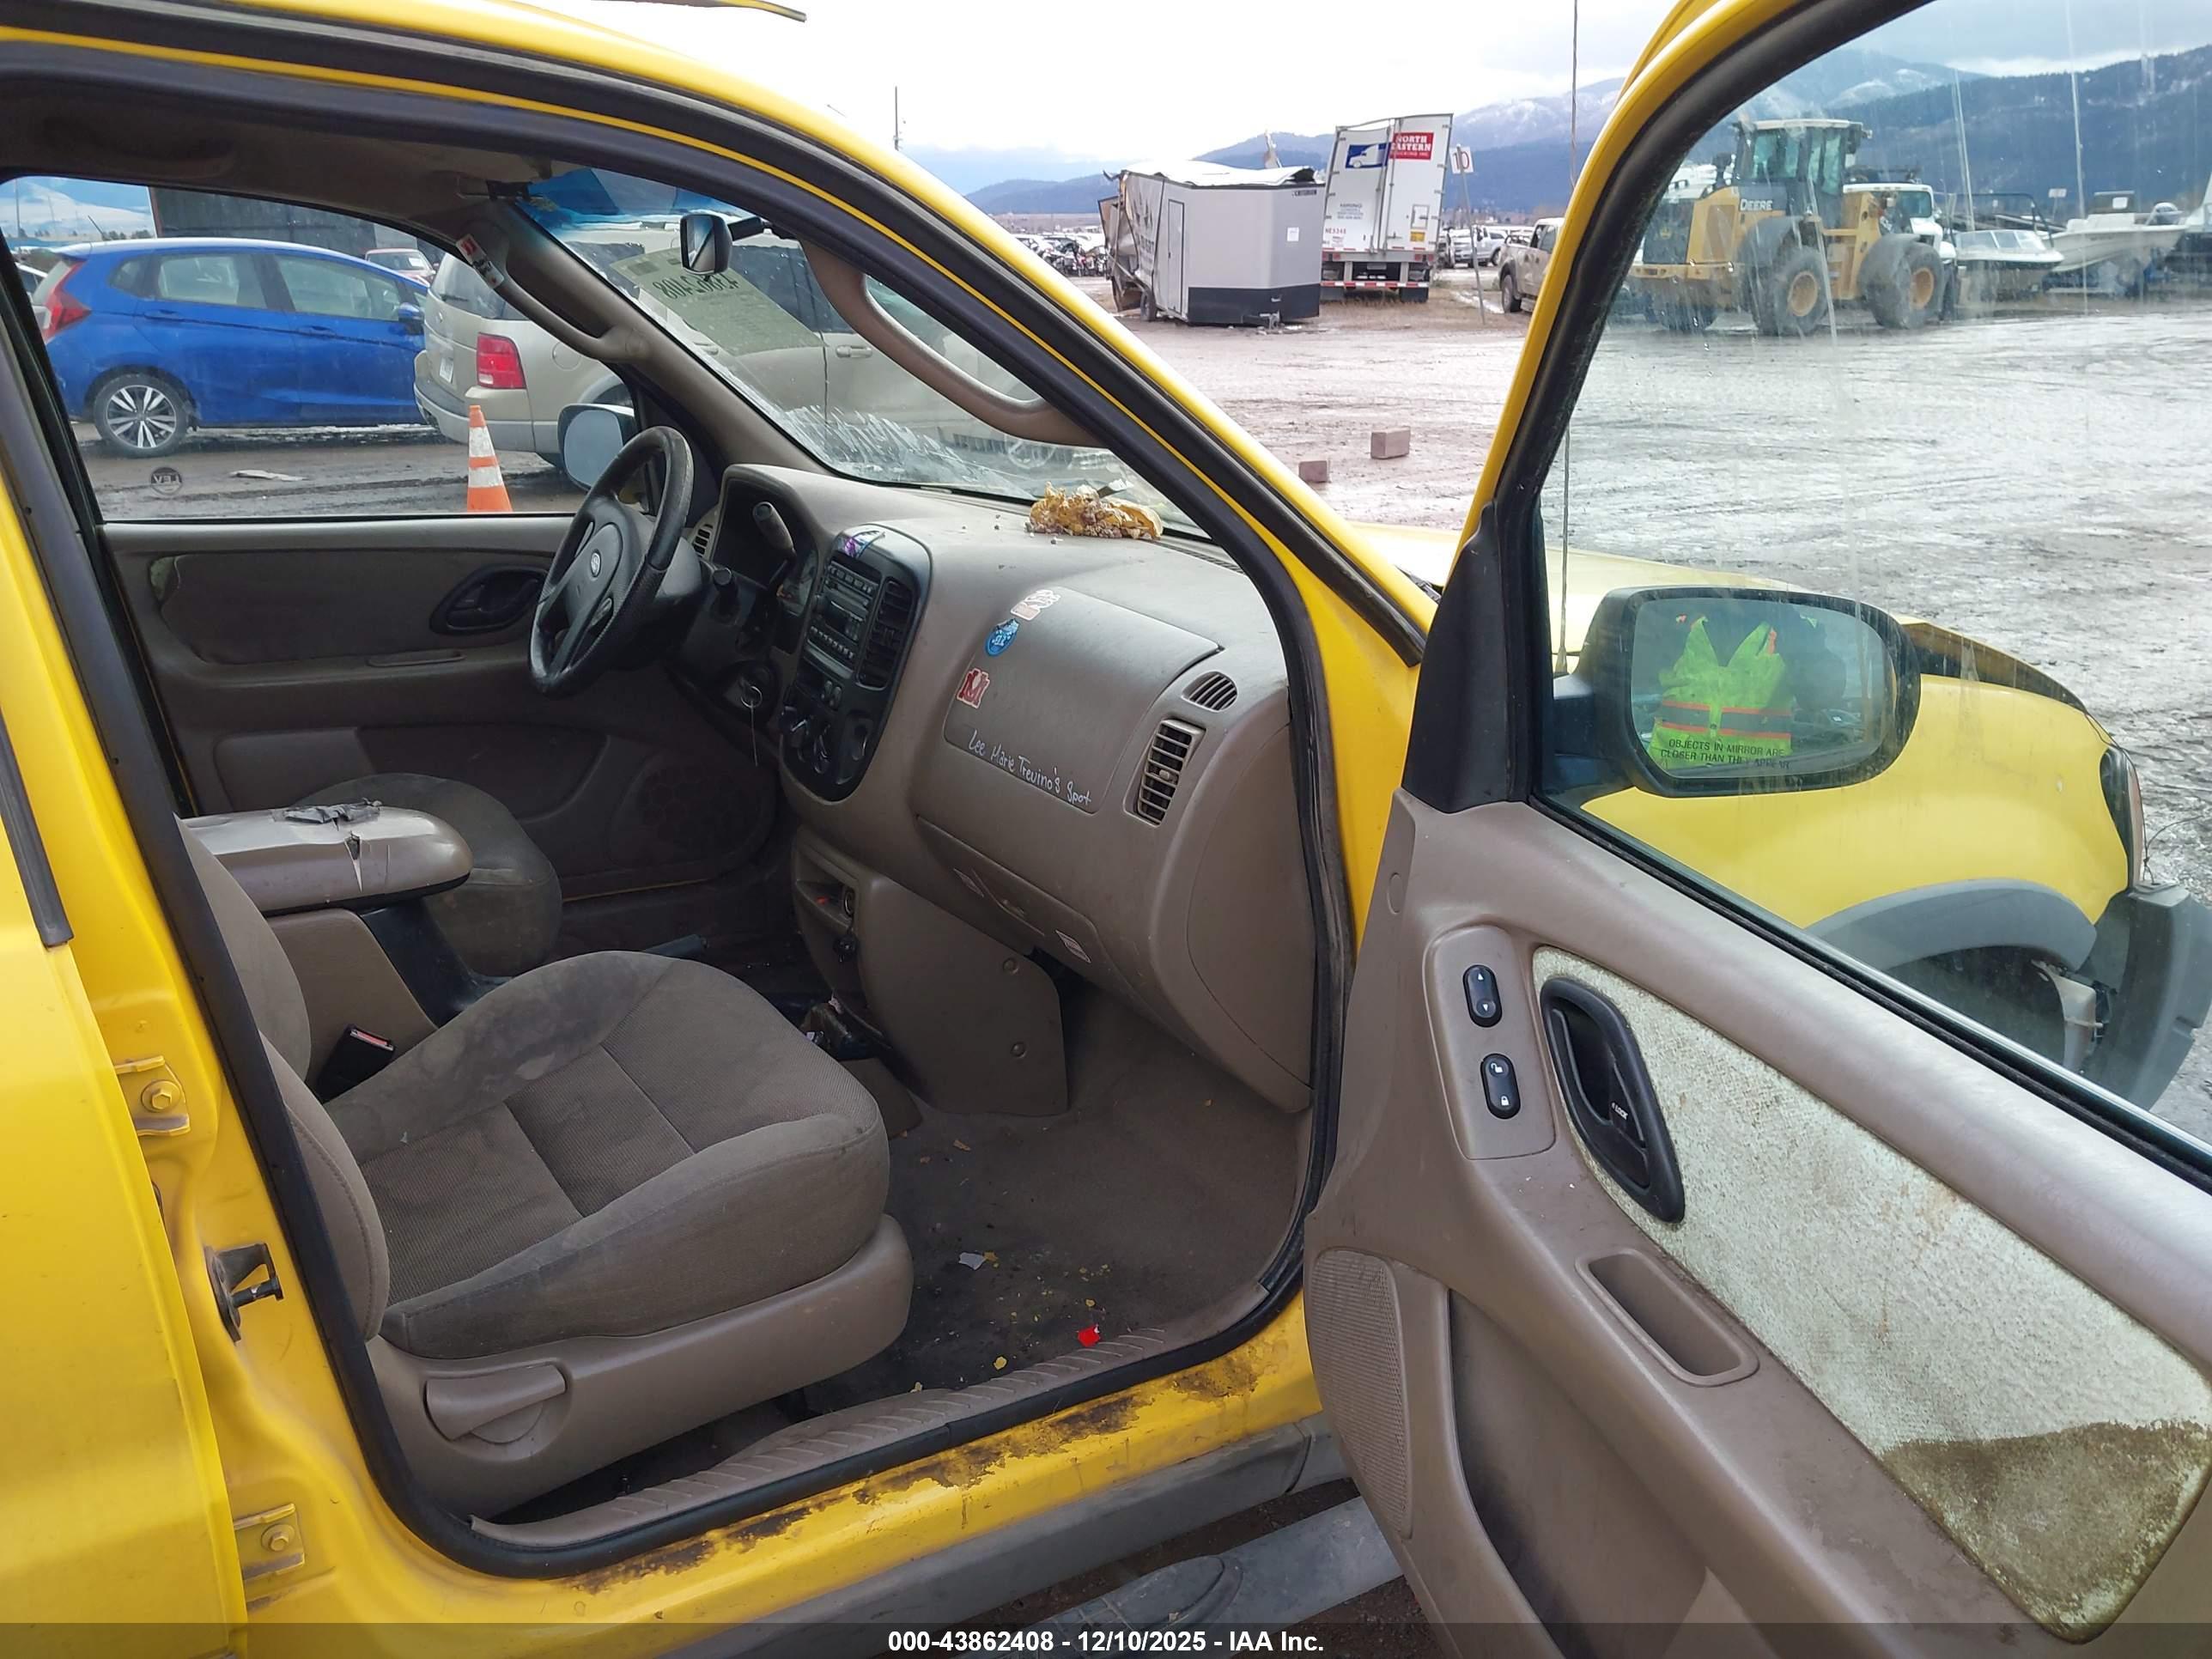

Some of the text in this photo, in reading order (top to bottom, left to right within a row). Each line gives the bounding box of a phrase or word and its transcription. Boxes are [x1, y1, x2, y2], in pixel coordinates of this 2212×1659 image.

[1740, 198, 1773, 210] DEERE
[1668, 738, 1785, 757] OBJECTS IN MIRROR ARE
[1661, 749, 1697, 761] CLOSER
[1700, 752, 1724, 763] THAN
[969, 730, 1092, 805] Lee Marie Trevino's Spot
[1614, 1104, 1628, 1120] LOCK
